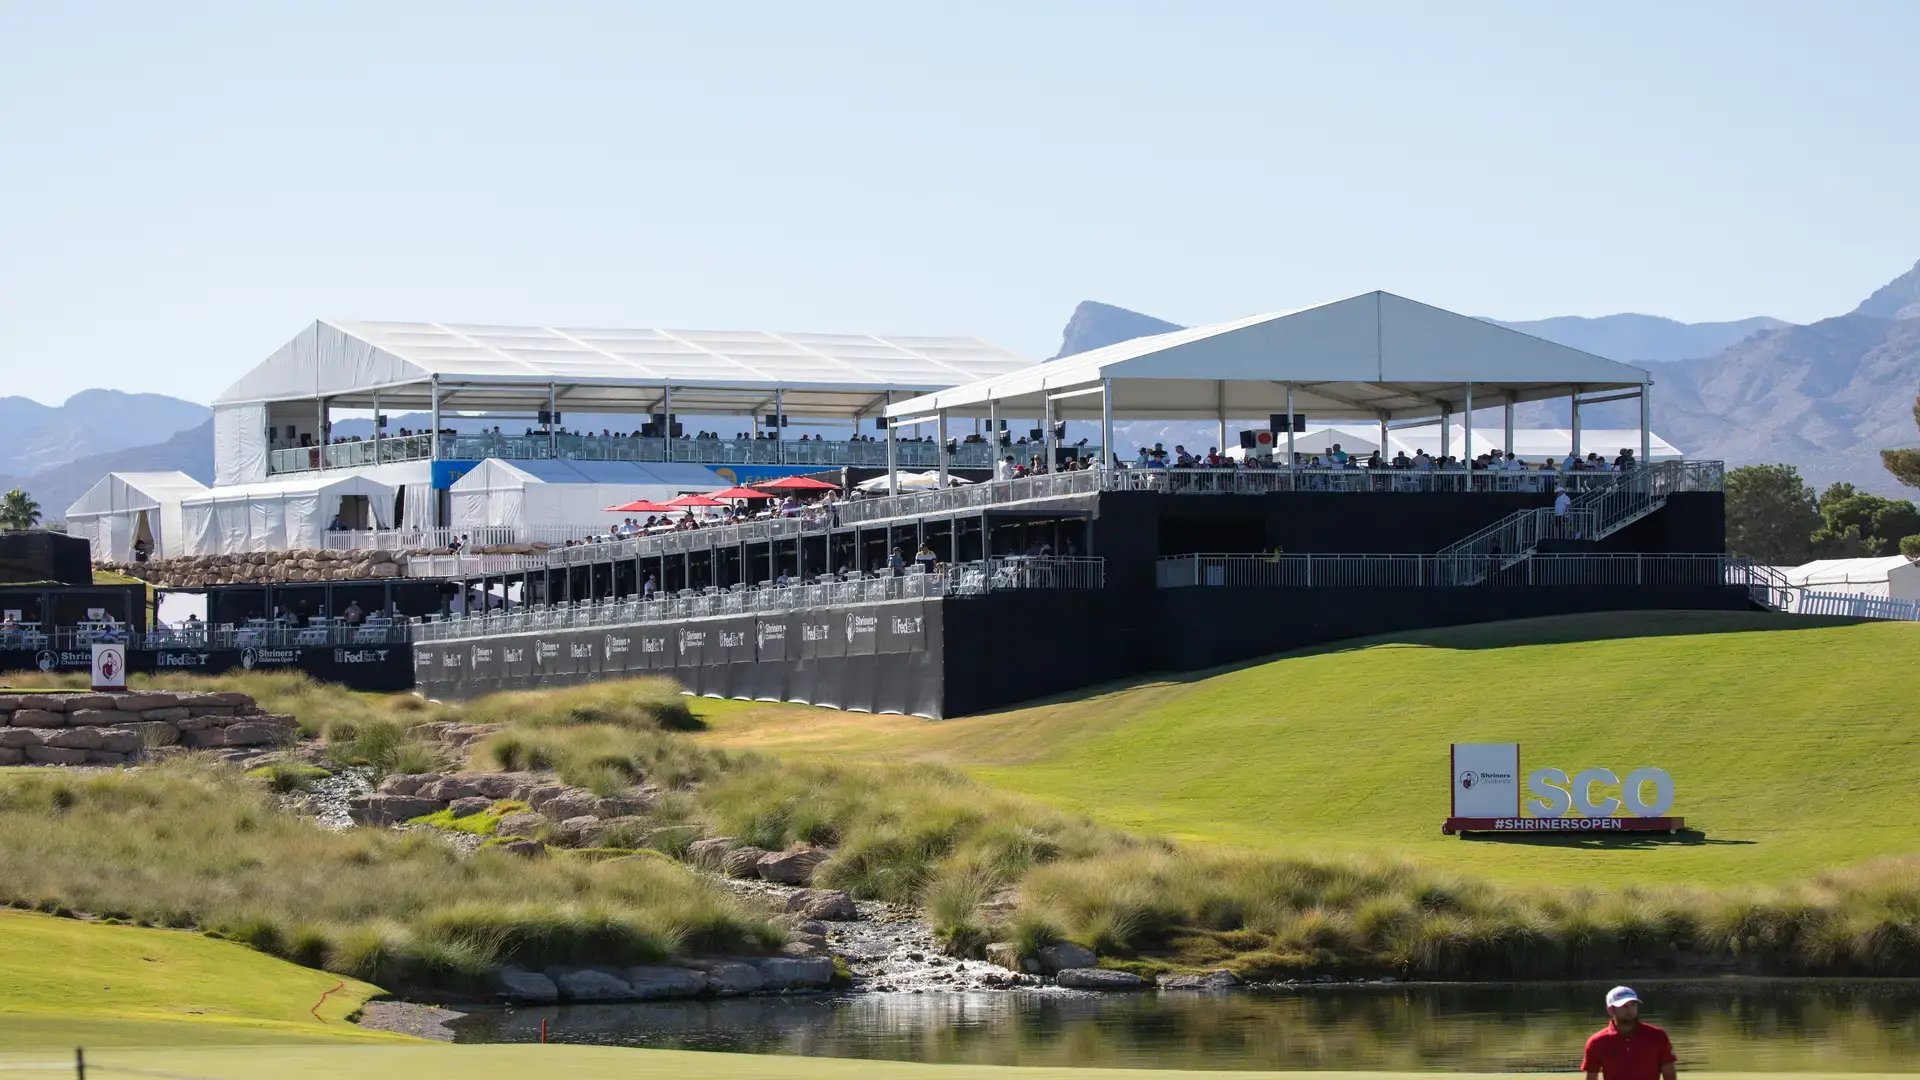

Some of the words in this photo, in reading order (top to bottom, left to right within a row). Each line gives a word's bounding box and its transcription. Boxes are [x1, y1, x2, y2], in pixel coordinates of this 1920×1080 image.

[61, 652, 92, 660] Shrin
[166, 653, 197, 666] FedEx
[258, 649, 293, 658] Shriners
[344, 650, 376, 663] FedEx
[1527, 767, 1675, 818] SCO
[1494, 818, 1622, 830] #SHRINERSOPEN
